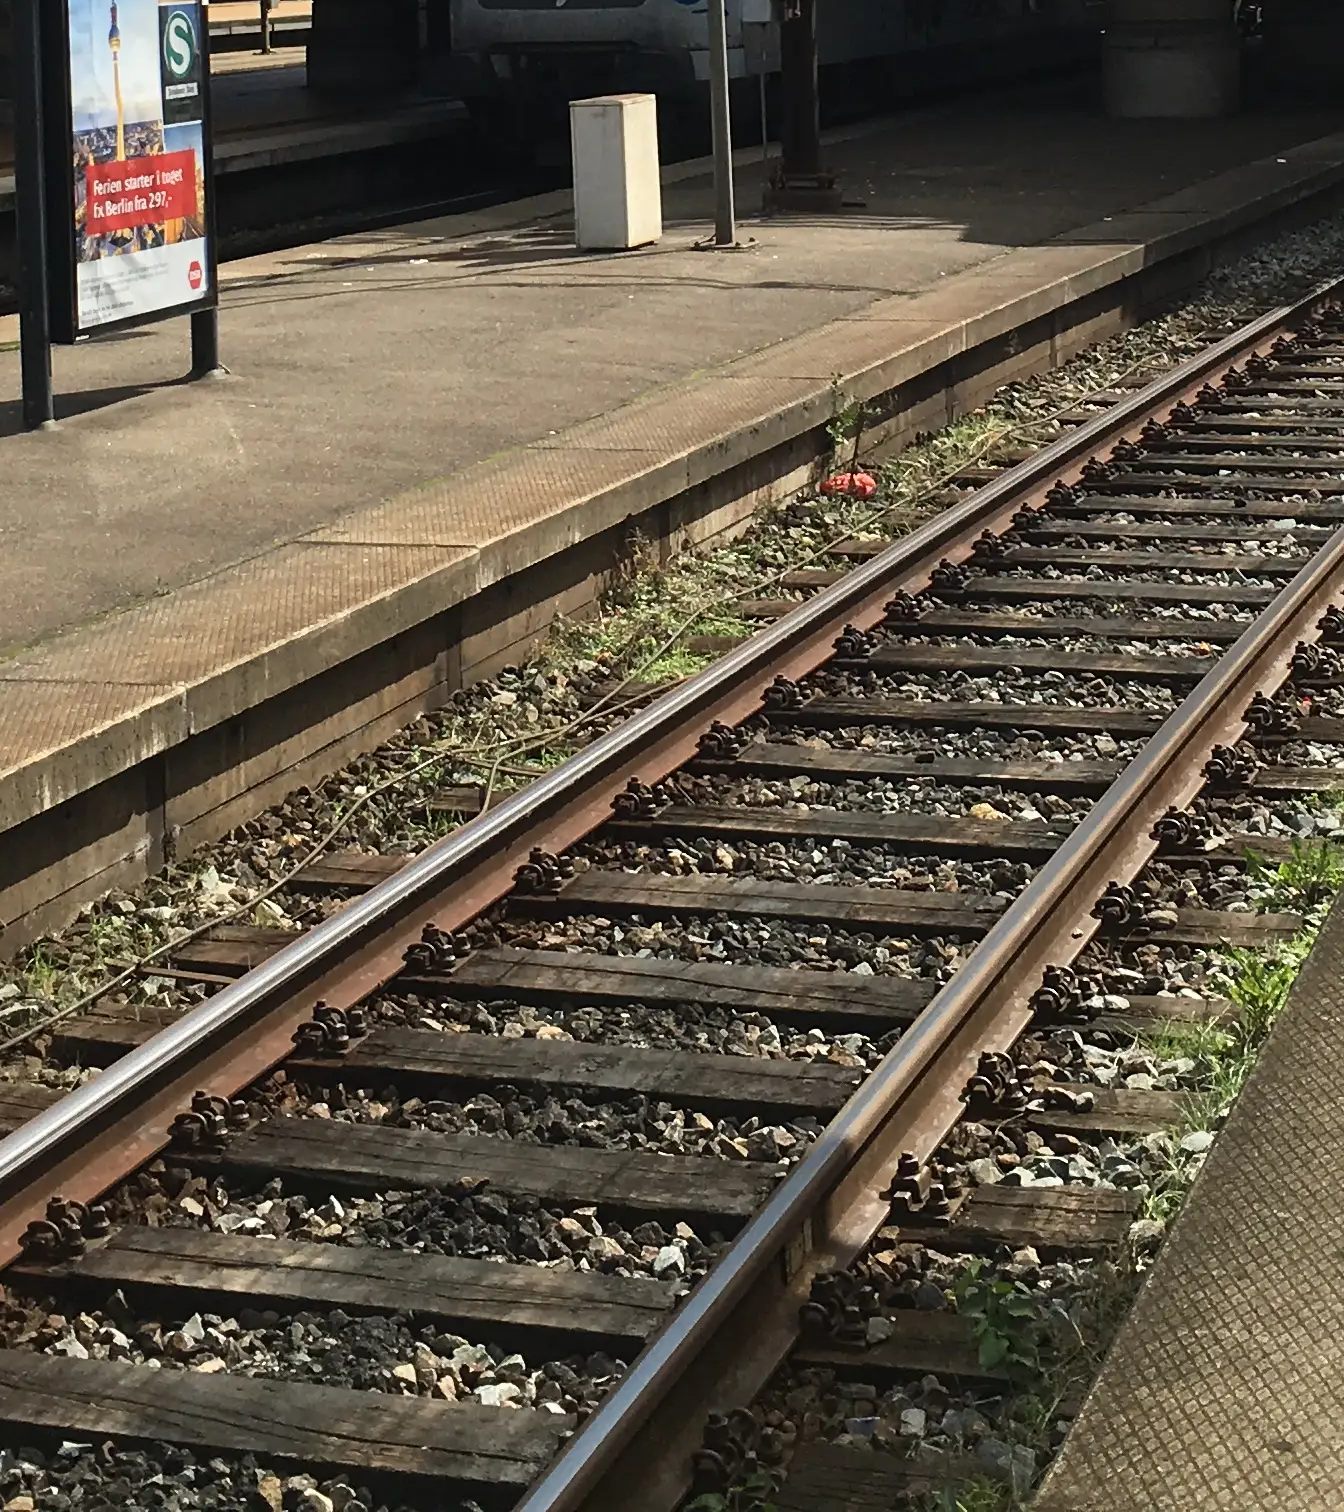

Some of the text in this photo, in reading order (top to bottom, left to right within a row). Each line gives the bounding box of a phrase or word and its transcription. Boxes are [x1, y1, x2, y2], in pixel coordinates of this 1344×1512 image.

[168, 17, 191, 75] S
[93, 178, 122, 196] Ferien
[124, 174, 155, 191] starter
[161, 168, 183, 185] toget
[93, 190, 173, 219] fx Berlin fra 297,-
